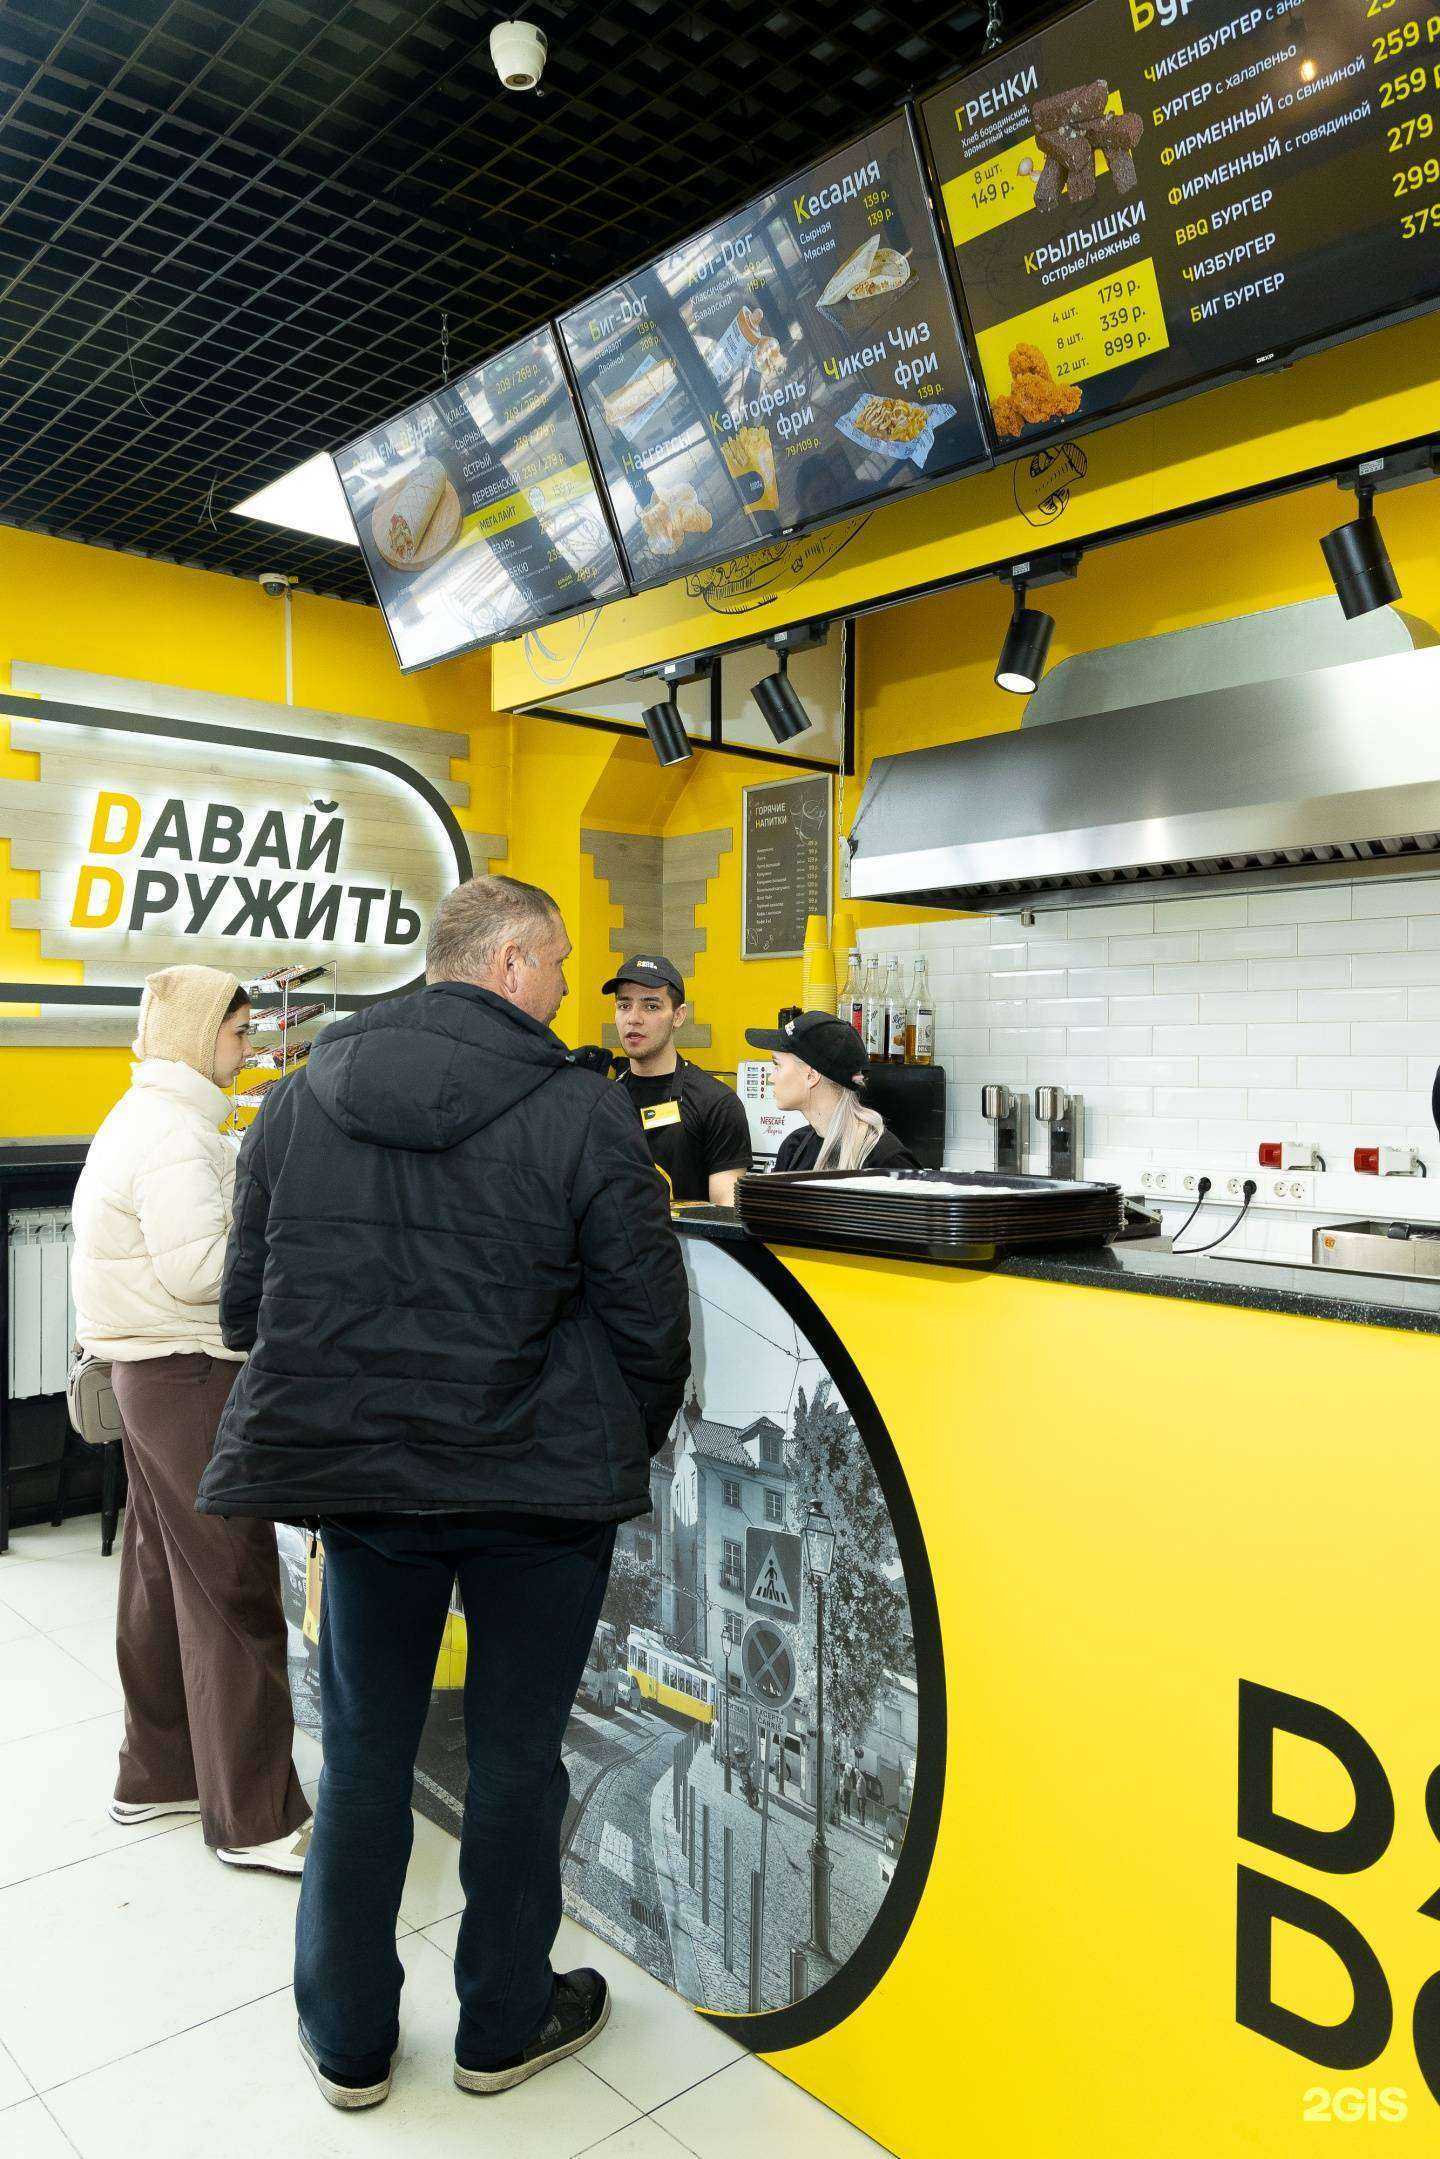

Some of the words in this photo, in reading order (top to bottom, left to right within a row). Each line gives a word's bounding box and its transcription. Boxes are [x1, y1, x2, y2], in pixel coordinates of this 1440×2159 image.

[1144, 8, 1262, 84] ЧИКЕНБУРГЕР
[1265, 8, 1275, 21] с
[1371, 21, 1420, 64] 259
[953, 65, 1039, 132] ГРЕНКИ
[1152, 82, 1212, 127] БУРГЕР
[1215, 82, 1224, 95] с
[1225, 44, 1298, 90] халапеньо
[1378, 66, 1427, 109] 259
[1160, 94, 1275, 167] ФИРМЕННЫЙ
[1277, 95, 1294, 110] со
[1296, 55, 1367, 101] свининой
[1387, 113, 1434, 153] 279
[961, 131, 980, 148] Хлеб
[963, 129, 1004, 158] ароматный
[1168, 136, 1282, 207] ФИРМЕННЫЙ
[1285, 140, 1293, 152] с
[1295, 100, 1372, 149] говядиной
[793, 160, 881, 225] Кесадия
[971, 183, 997, 209] 149
[1001, 180, 1015, 199] р.
[974, 172, 982, 185] 8
[984, 163, 1002, 181] шт.
[1392, 158, 1440, 198] 299
[799, 221, 832, 246] Сырная
[863, 194, 880, 210] 139
[803, 238, 836, 263] Мясная
[867, 213, 884, 229] 139
[1024, 200, 1147, 275] КРЫЛЫШКИ
[1175, 219, 1210, 246] BBQ
[1211, 189, 1273, 231] БУРГЕР
[1040, 231, 1141, 287] острые/нежные
[1182, 232, 1277, 283] ЧИЗБУРГЕР
[1052, 313, 1059, 325] 4
[1061, 307, 1079, 321] шт.
[1097, 282, 1123, 305] 179
[1126, 279, 1141, 297] р.
[1190, 298, 1222, 324] БИГ
[1224, 271, 1285, 310] БУРГЕР
[823, 340, 887, 381] Чикен
[888, 322, 931, 352] Чиз
[1056, 337, 1065, 350] 8
[1066, 333, 1084, 347] шт.
[1099, 308, 1129, 333] 339
[1132, 306, 1146, 325] р.
[894, 351, 939, 390] фри
[1056, 363, 1071, 378] 22
[1071, 358, 1090, 374] шт.
[1104, 334, 1134, 357] 899
[1137, 332, 1151, 351] р.
[709, 380, 807, 436] Картофель
[776, 404, 815, 441] фри
[918, 385, 934, 400] 139
[88, 790, 346, 874] DАВАЙ
[755, 802, 786, 817] ГОРЯЧИЕ
[755, 815, 787, 829] НАПИТКИ
[70, 864, 422, 946] DРУЖИТЬ
